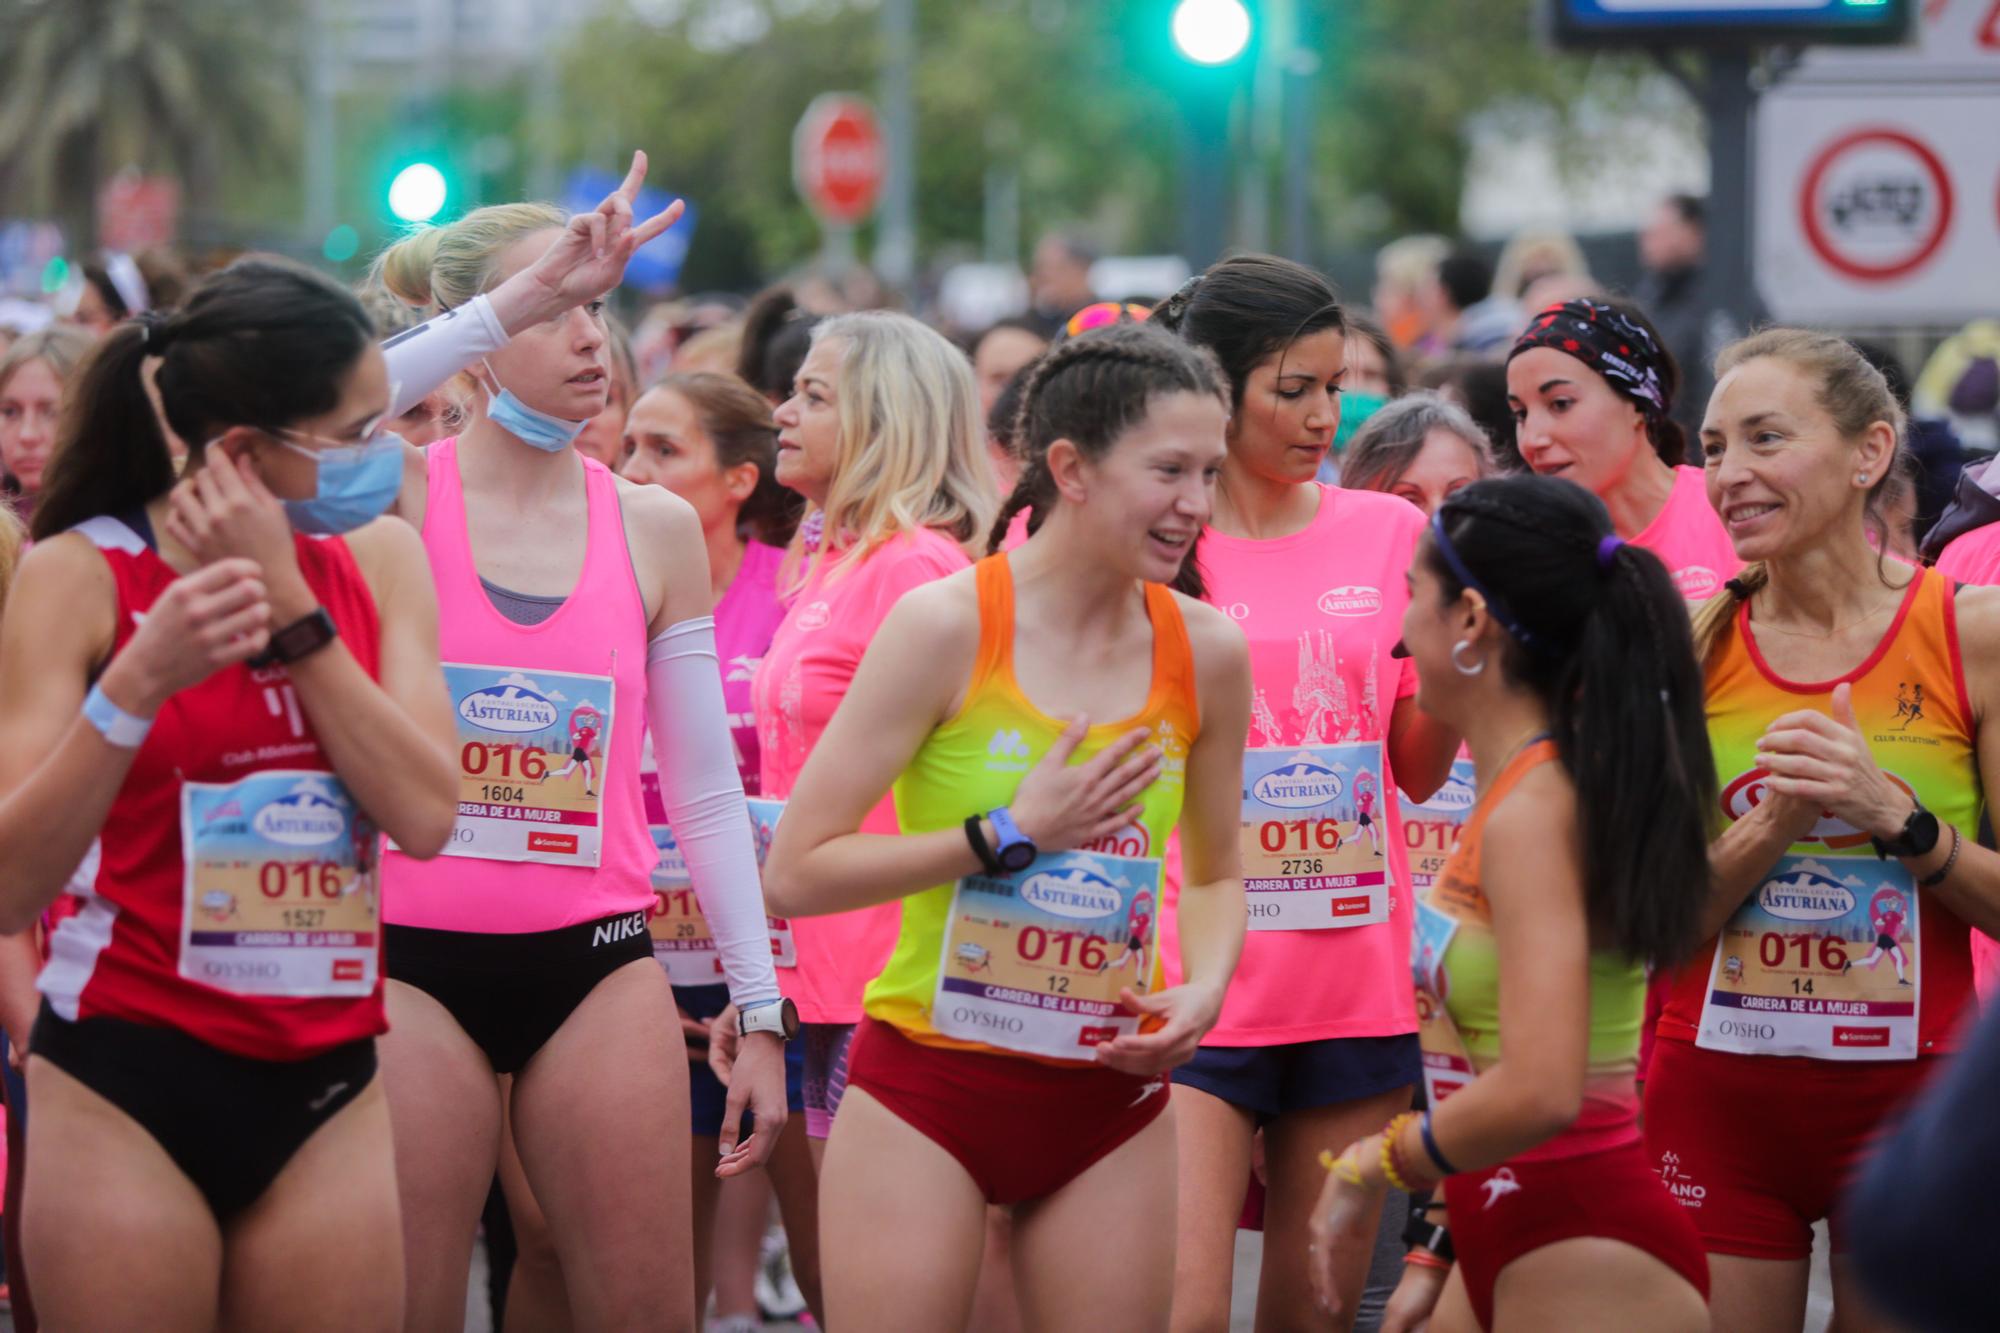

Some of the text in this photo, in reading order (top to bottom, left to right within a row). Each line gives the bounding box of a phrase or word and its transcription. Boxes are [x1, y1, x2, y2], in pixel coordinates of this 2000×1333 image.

[465, 699, 551, 724] ASTURIANA
[461, 741, 547, 780] 016
[481, 785, 525, 803] 1604
[1260, 781, 1338, 799] ASTURIANA
[490, 806, 505, 818] DE
[507, 807, 522, 819] LA
[524, 809, 561, 822] MUJER
[1260, 817, 1340, 852] 016
[1281, 858, 1324, 875] 2736
[259, 859, 340, 899] 016
[1293, 878, 1307, 890] DE
[1309, 877, 1323, 889] LA
[1325, 875, 1358, 888] MUJER
[1028, 880, 1116, 912] ASTURIANA
[1762, 886, 1848, 912] ASTURIANA
[283, 910, 326, 928] 1527
[592, 911, 644, 947] NIKE
[1016, 925, 1109, 971] 016
[1759, 931, 1849, 971] 016
[203, 960, 281, 978] OYSHO
[1047, 974, 1071, 994] 12
[1791, 977, 1814, 994] 14
[984, 985, 1115, 1016] CARRERA DE LA MUJER
[1740, 995, 1868, 1015] CARRERA DE LA MUJER
[952, 1006, 1024, 1034] OYSHO
[1719, 1019, 1776, 1041] OYSHO
